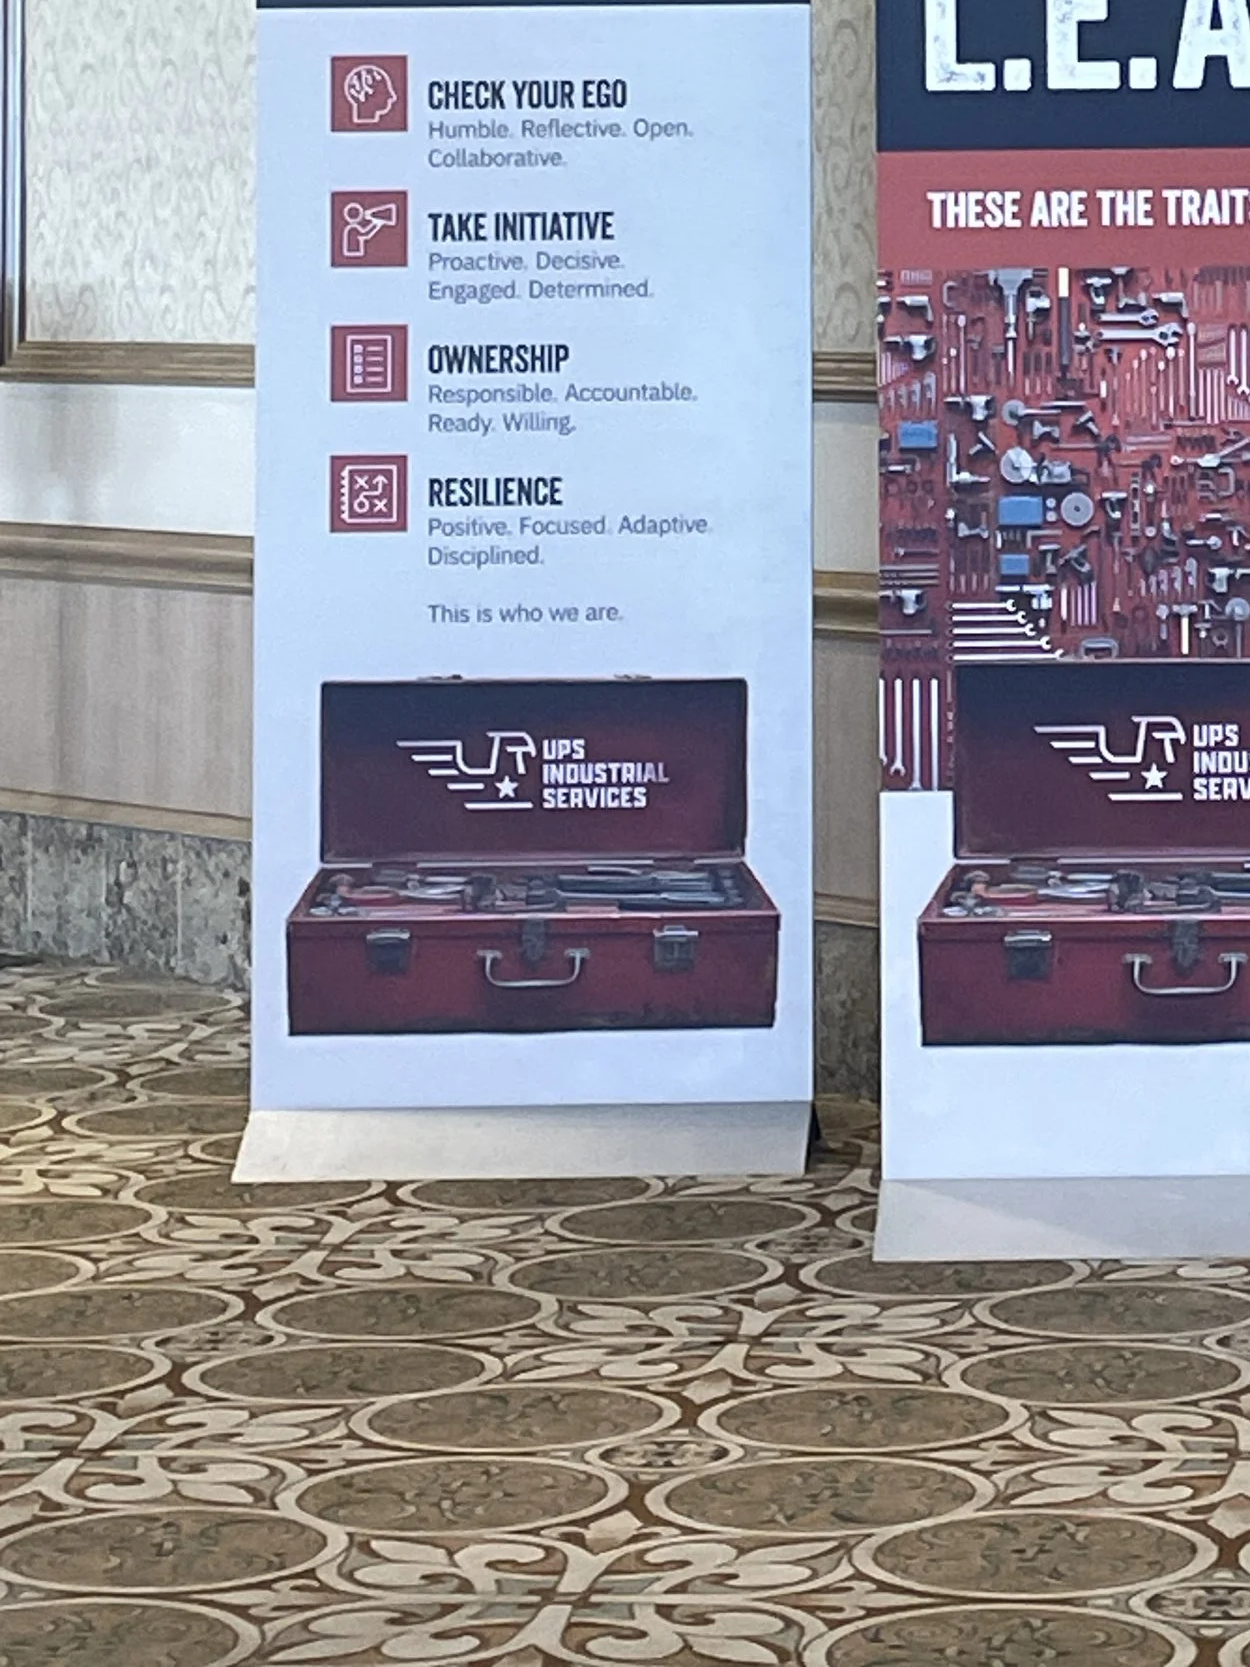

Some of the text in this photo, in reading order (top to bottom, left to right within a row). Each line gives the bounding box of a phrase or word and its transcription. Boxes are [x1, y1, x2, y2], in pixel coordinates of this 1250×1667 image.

[428, 79, 628, 110] CHECK YOUR EGO
[428, 118, 694, 141] Humble. Reflective. Open.
[428, 148, 567, 168] Collaborative.
[927, 191, 1022, 228] THESE
[1030, 190, 1088, 227] ARE
[1096, 190, 1154, 226] THE
[428, 212, 615, 242] TAKE INITIATIVE
[428, 252, 625, 270] Proactive. Decisive.
[428, 279, 654, 304] Engaged. Determined.
[428, 344, 570, 374] OWNERSHIP
[428, 382, 698, 406] Responsible. Accountable.
[428, 412, 576, 436] Ready. Willing.
[428, 477, 563, 507] RESILIENCE
[428, 518, 512, 536] Positive.
[428, 546, 544, 569] Disciplined.
[428, 604, 623, 623] This is who we are.
[1193, 724, 1239, 747] UPS
[542, 739, 585, 759] UPS
[542, 762, 670, 784] INDUSTRIAL
[542, 787, 646, 809] SERVICES
